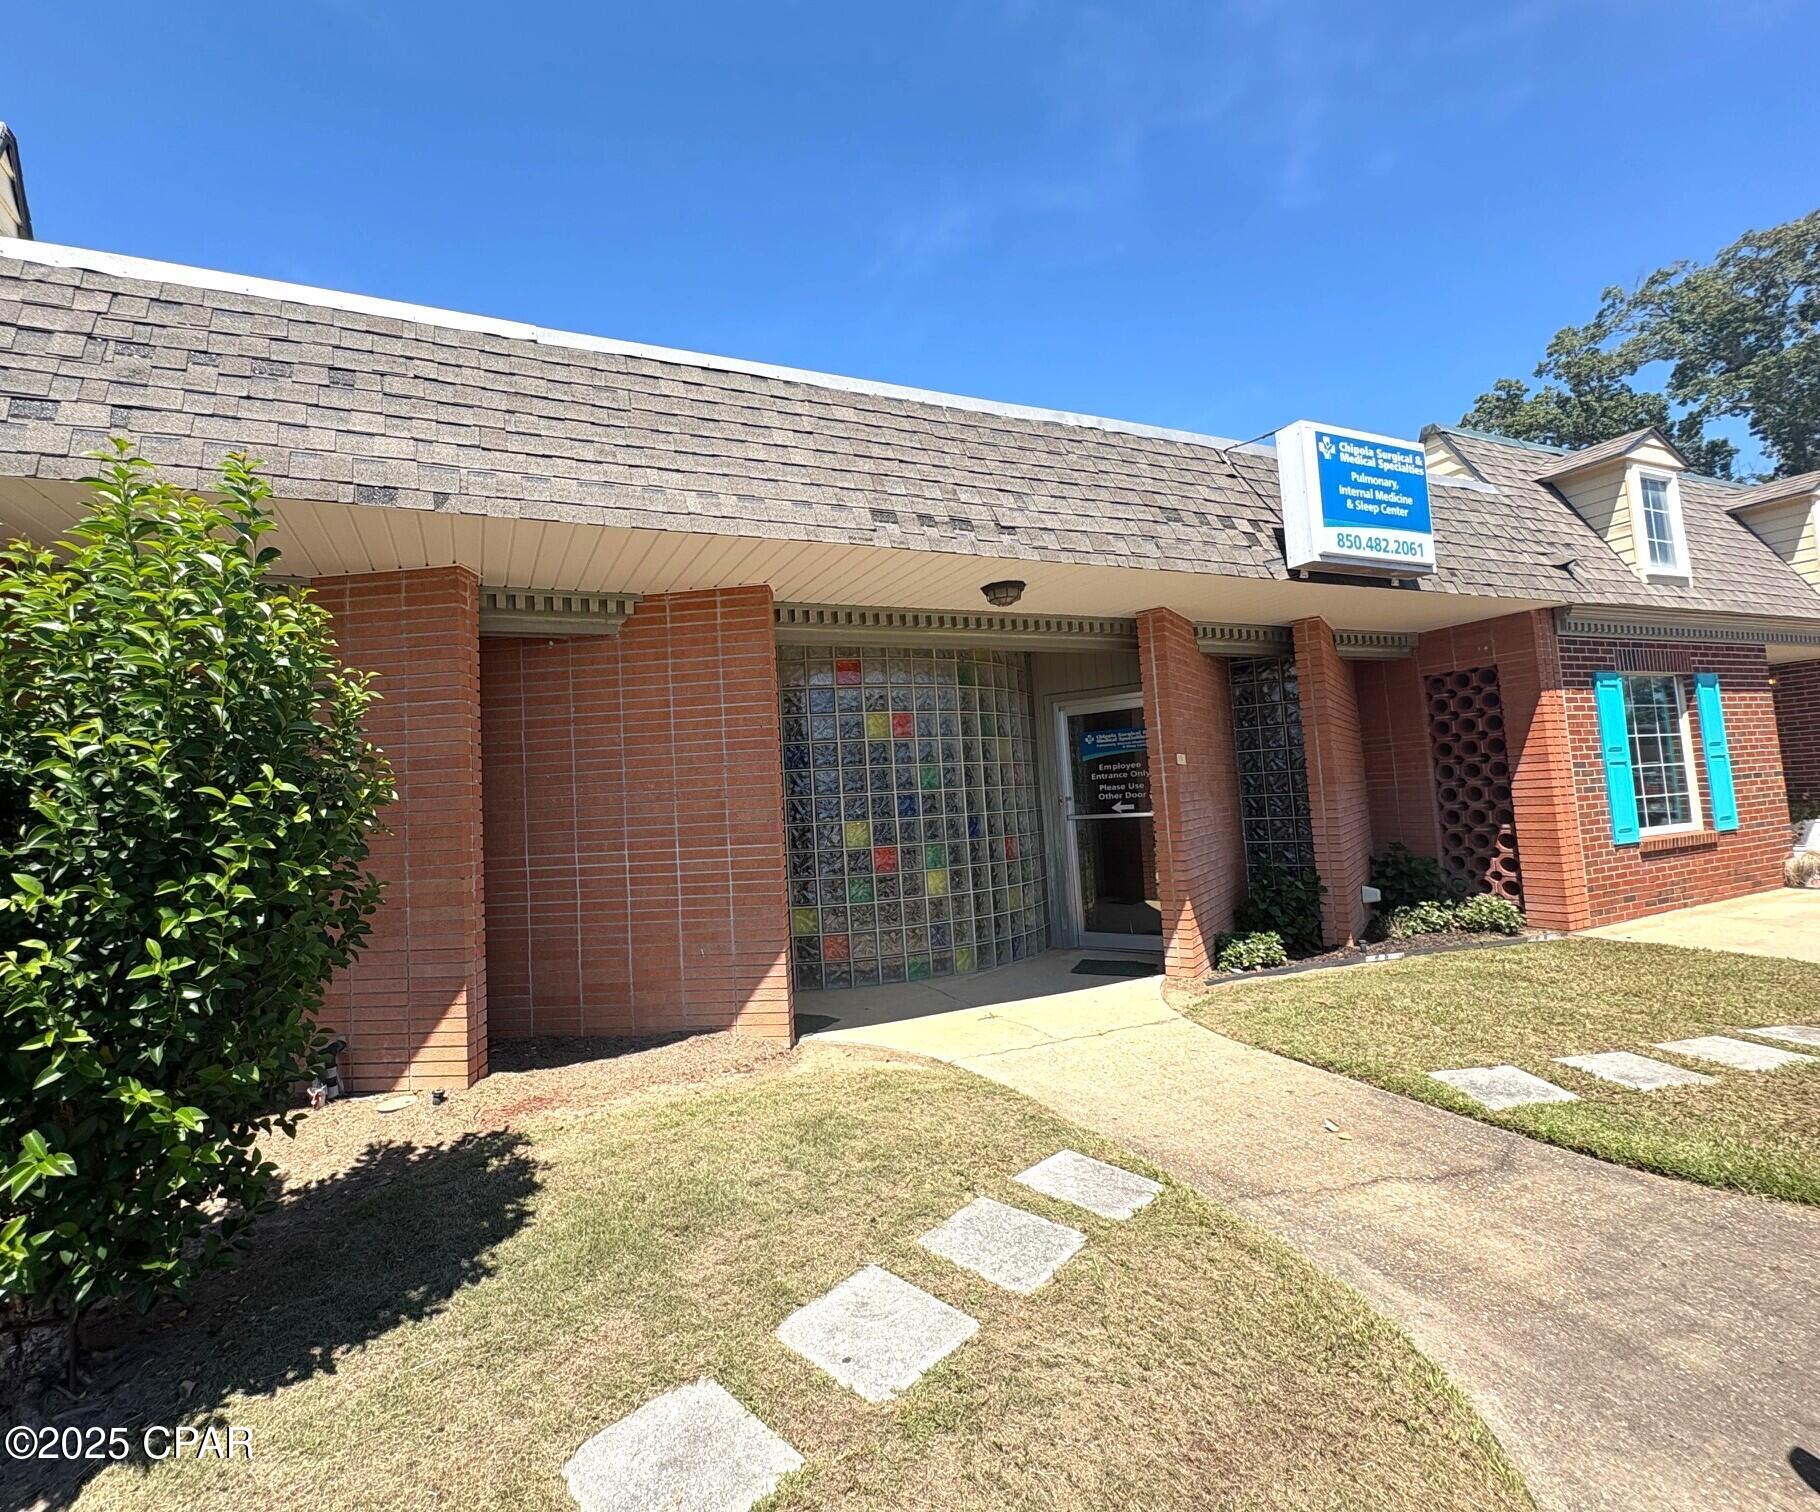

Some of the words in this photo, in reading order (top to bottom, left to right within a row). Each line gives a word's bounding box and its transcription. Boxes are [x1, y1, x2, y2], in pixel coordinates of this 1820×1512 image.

[1339, 442, 1374, 456] Chipola
[1375, 448, 1413, 463] Surgical
[1414, 455, 1424, 466] &
[1340, 452, 1376, 467] Medical
[1377, 459, 1425, 476] Specialties
[1351, 472, 1399, 490] Pulmonary,
[1338, 484, 1374, 499] Internal
[1374, 490, 1414, 506] Medicine
[1346, 498, 1355, 510] &
[1355, 499, 1380, 515] Sleep
[1380, 503, 1409, 517] Center
[1337, 533, 1424, 557] 850.482.2061
[1098, 762, 1141, 771] Employee
[1091, 772, 1128, 781] Entrance
[1099, 783, 1126, 791] Please
[1128, 782, 1144, 790] Use
[1098, 792, 1123, 801] Other
[1125, 791, 1147, 800] Door
